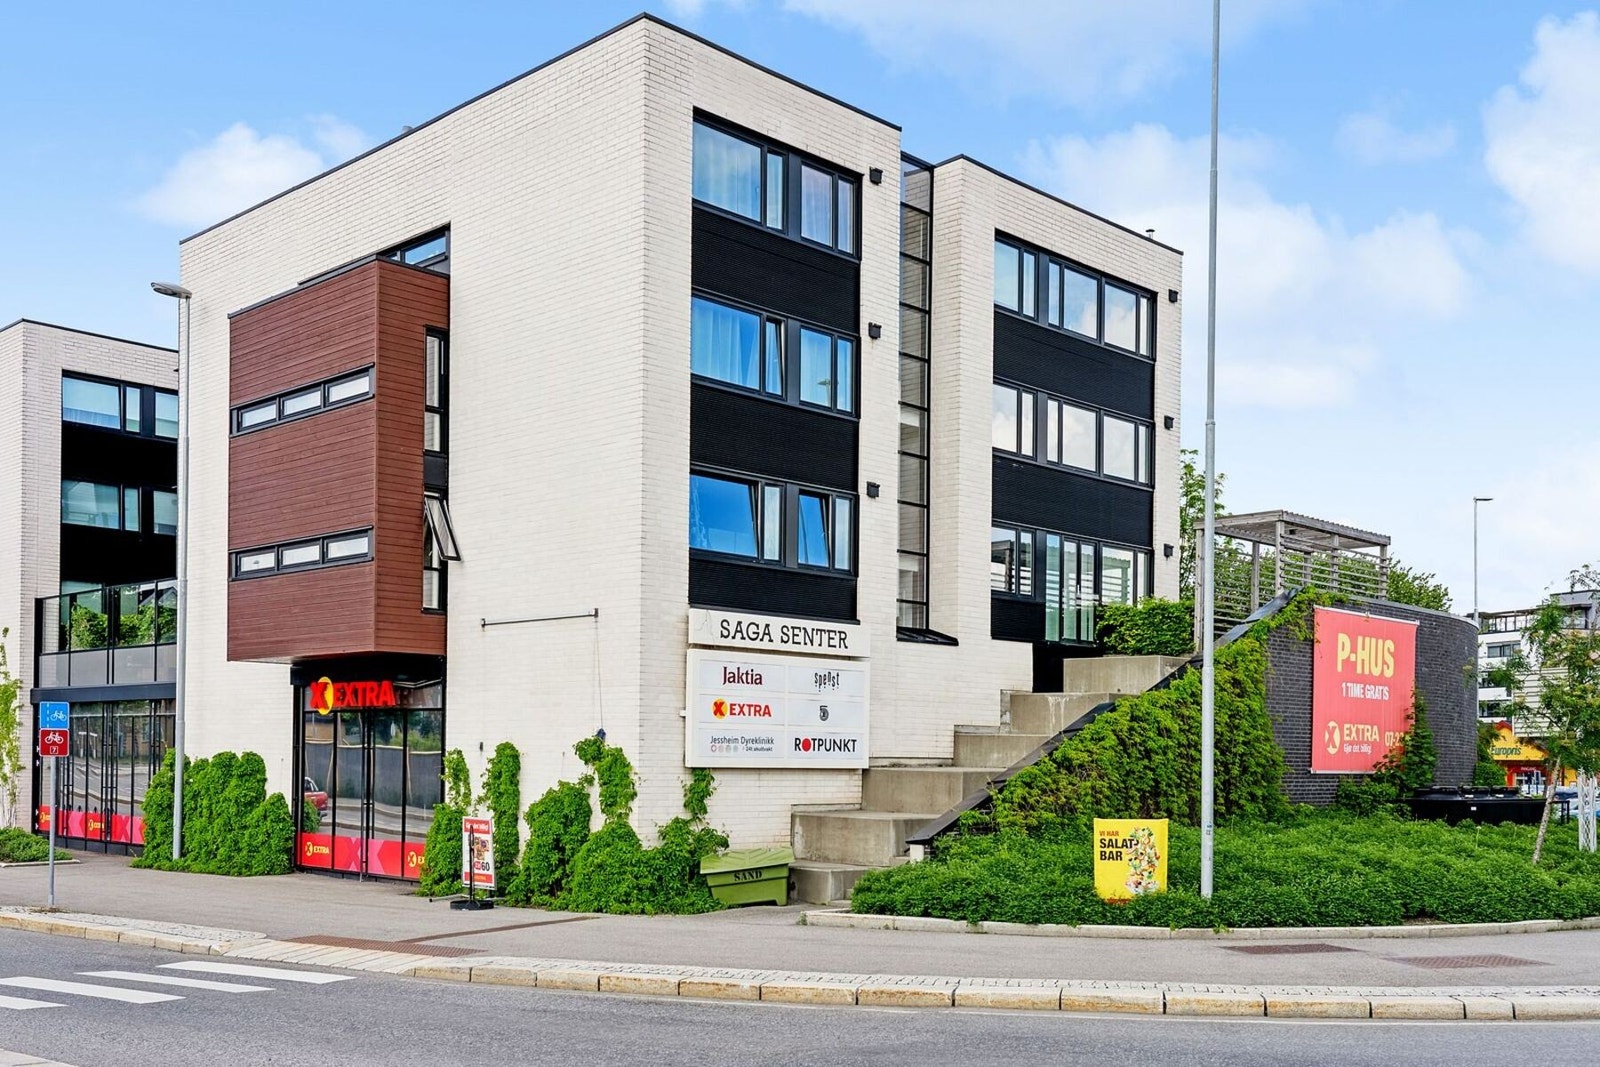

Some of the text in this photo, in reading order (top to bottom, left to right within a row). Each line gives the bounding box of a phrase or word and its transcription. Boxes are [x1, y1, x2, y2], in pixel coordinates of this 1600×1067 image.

[720, 618, 848, 649] SAGA SENTER
[1337, 632, 1395, 678] P-HUS
[722, 666, 763, 685] Jaktia
[814, 671, 840, 692] spenst
[334, 681, 396, 707] EXTRA
[1342, 682, 1389, 700] 1 TIME GRATIS
[729, 703, 772, 718] EXTRA
[710, 735, 775, 747] Jessheim Dyreklinikk
[1343, 723, 1379, 742] EXTRA
[1491, 746, 1521, 758] Europris
[313, 846, 330, 855] EXTRA
[1099, 851, 1123, 861] BAR
[734, 870, 763, 881] SAND
